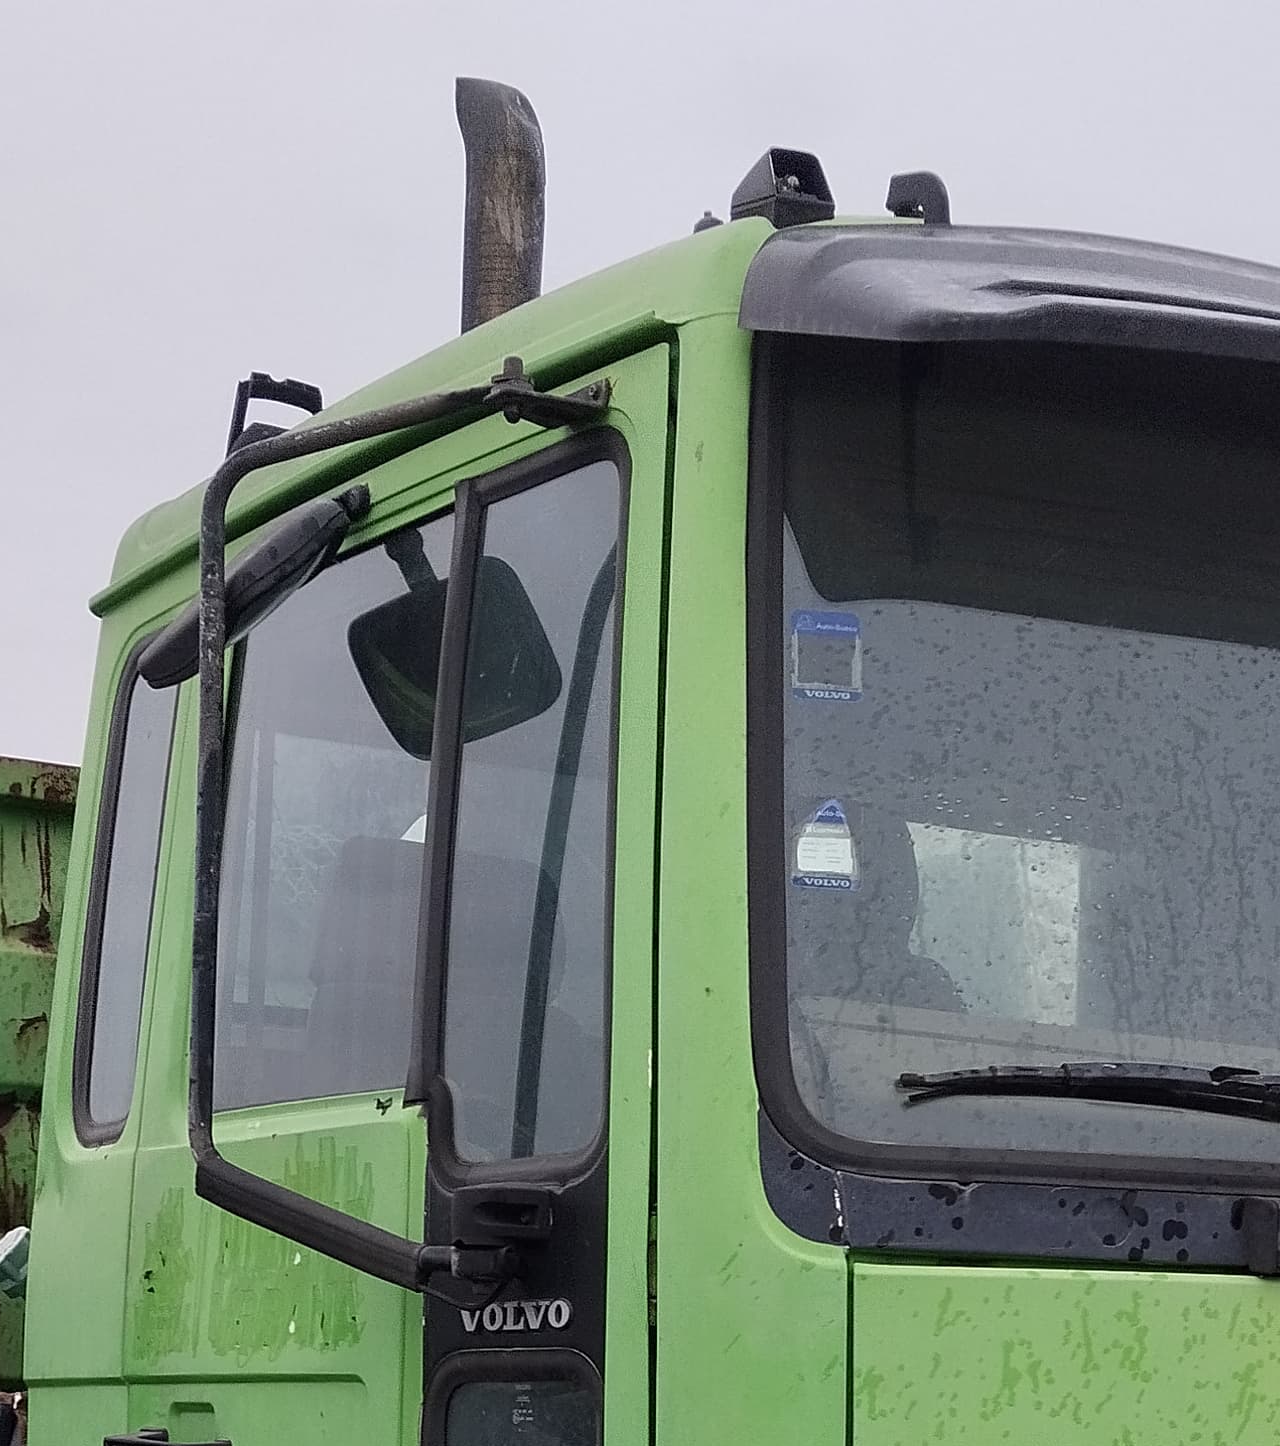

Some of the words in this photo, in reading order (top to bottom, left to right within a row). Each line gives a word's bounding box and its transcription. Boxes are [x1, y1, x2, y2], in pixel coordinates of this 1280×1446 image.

[804, 690, 851, 700] VOLVO
[803, 877, 850, 888] VOLVO
[460, 1299, 571, 1333] VOLVO
